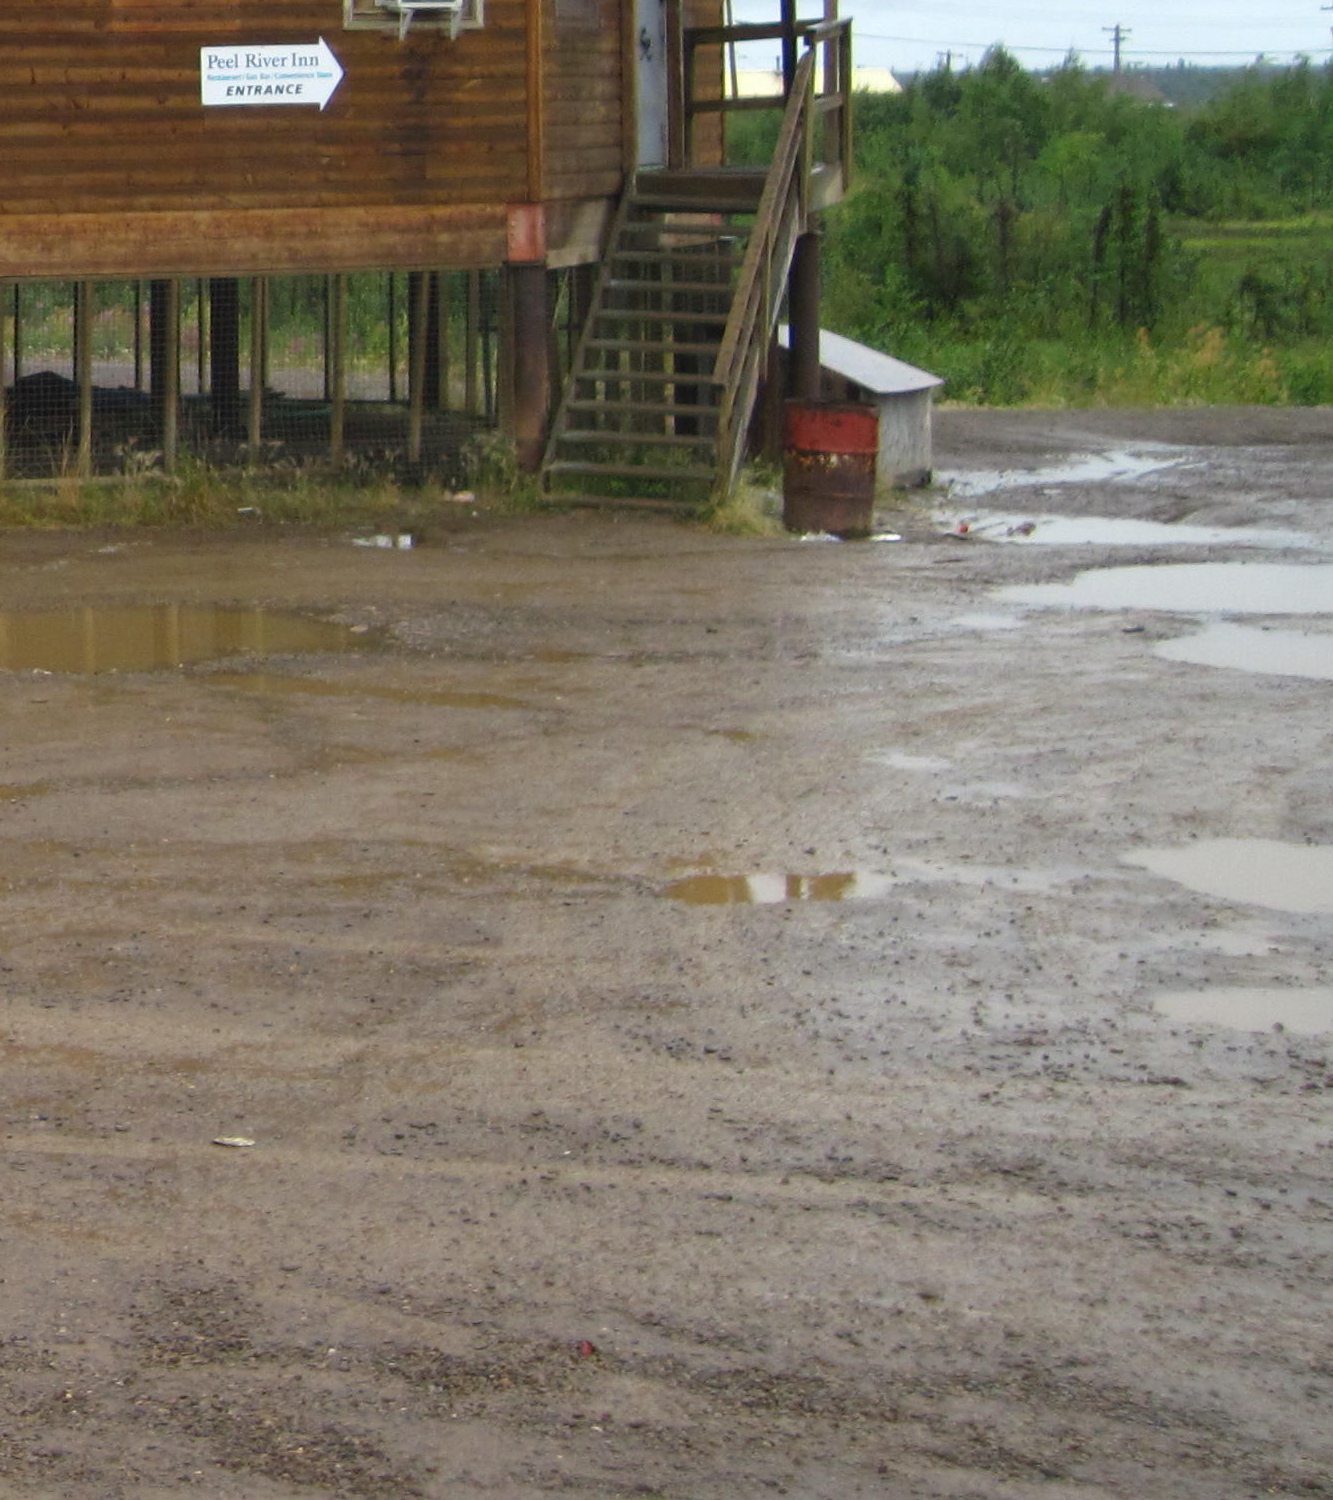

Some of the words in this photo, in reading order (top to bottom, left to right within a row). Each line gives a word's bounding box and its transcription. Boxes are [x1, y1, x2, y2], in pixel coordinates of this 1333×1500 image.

[207, 53, 239, 70] Peel
[245, 52, 289, 68] River
[292, 52, 319, 67] Inn
[226, 83, 303, 96] ENTRANCE
